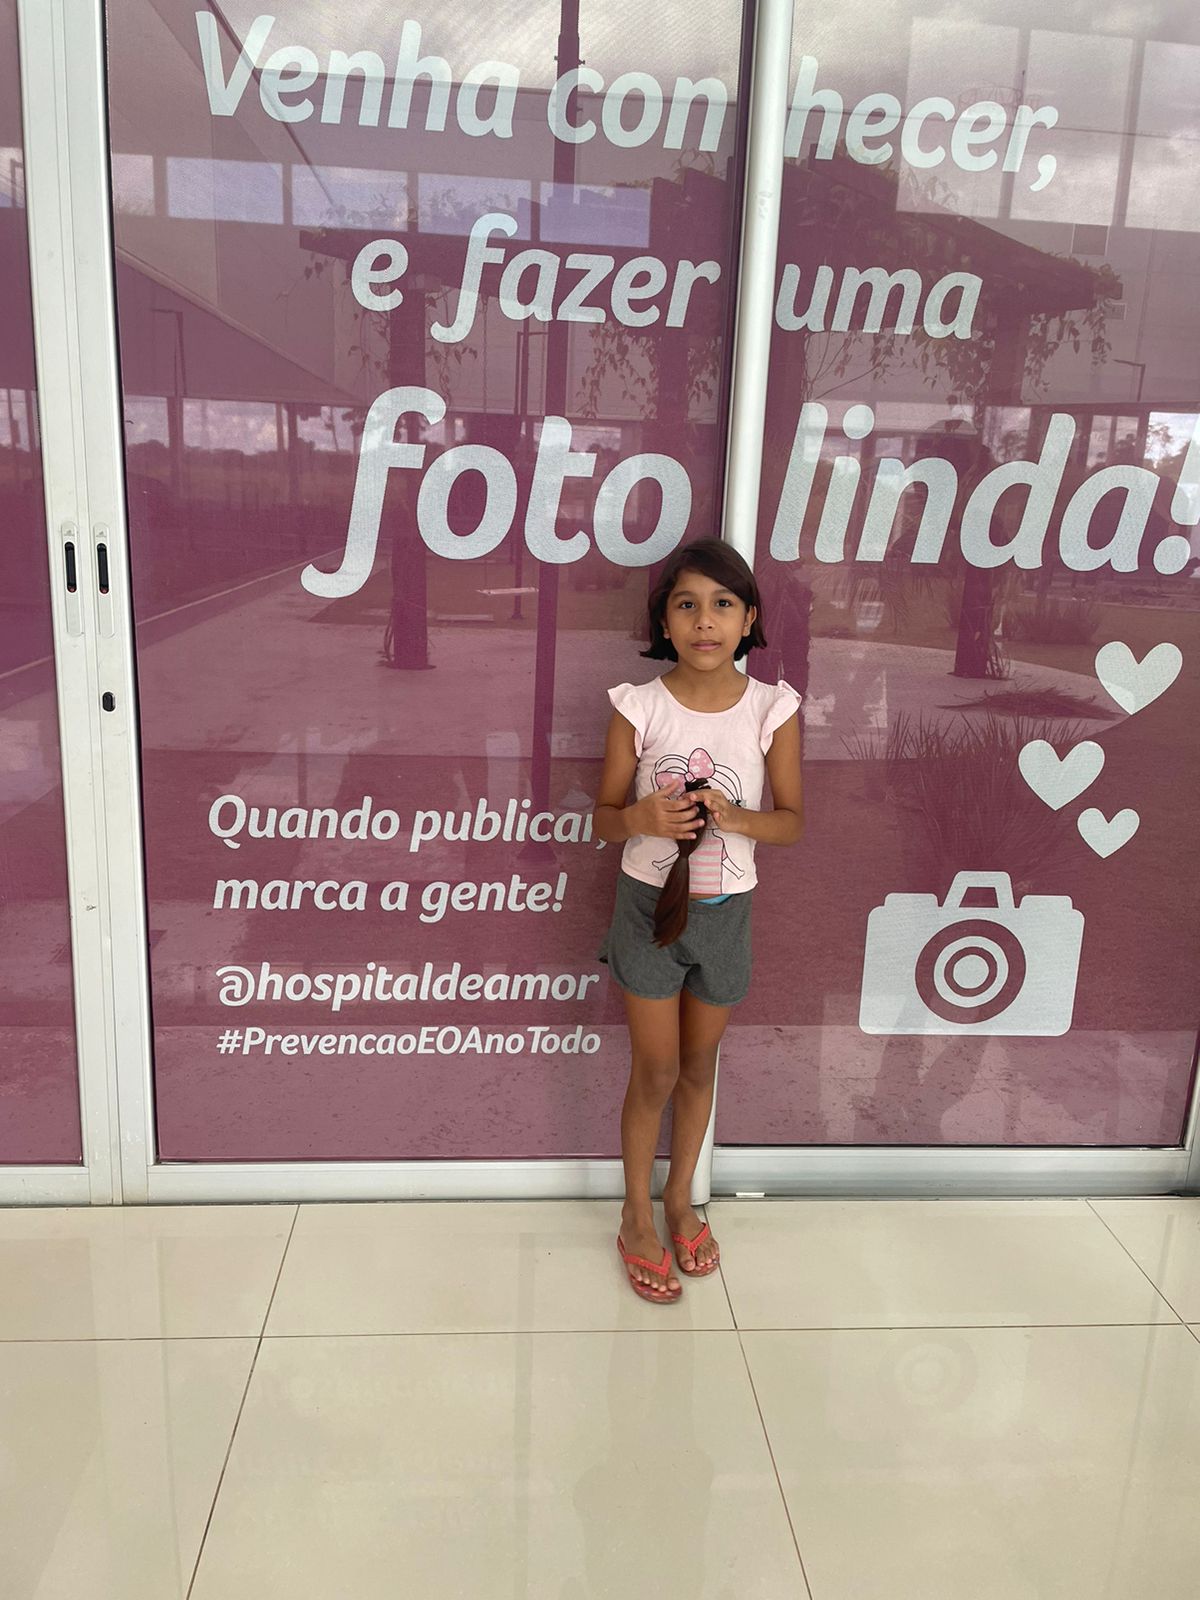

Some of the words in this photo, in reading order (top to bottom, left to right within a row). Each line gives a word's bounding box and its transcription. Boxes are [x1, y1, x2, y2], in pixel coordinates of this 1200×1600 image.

[195, 11, 521, 139] Venha
[351, 238, 409, 311] e
[430, 213, 722, 343] fazer
[775, 263, 984, 339] uma
[301, 386, 693, 598] foto
[769, 402, 1200, 575] linda!
[208, 794, 400, 849] Quando
[213, 878, 369, 911] marca
[380, 880, 409, 911] a
[419, 872, 568, 923] gente!
[216, 962, 600, 1012] @hospitaldeamor
[216, 1025, 601, 1055] #PrevencaoEOAnoTodo
